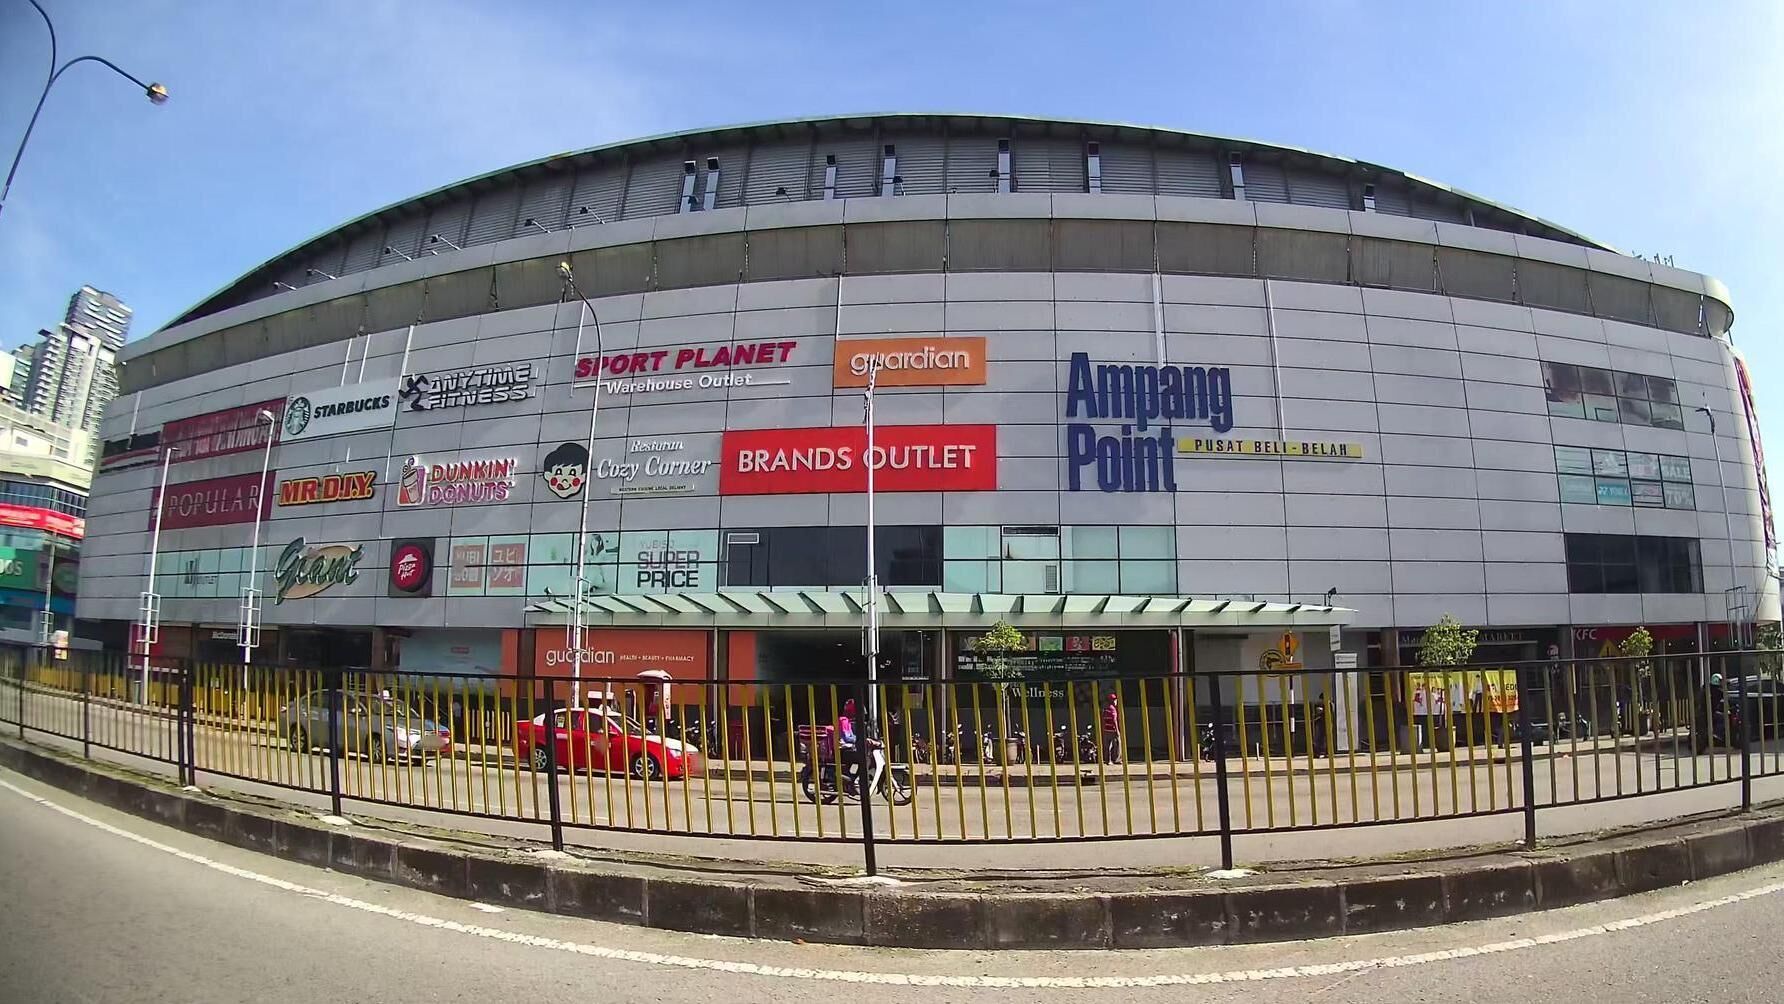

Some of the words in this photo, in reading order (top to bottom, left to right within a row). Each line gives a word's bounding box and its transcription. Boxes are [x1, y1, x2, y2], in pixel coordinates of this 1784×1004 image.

[575, 350, 668, 378] SPORT
[674, 342, 797, 370] PLANET
[850, 346, 970, 376] guardian
[430, 363, 532, 393] ANYTIME
[606, 378, 693, 395] Warehouse
[699, 373, 753, 389] Outlet
[427, 383, 529, 410] FITNESS
[1066, 352, 1234, 433] Ampang
[313, 395, 391, 418] STARBUCKS
[630, 440, 684, 453] Restoran
[738, 447, 852, 473] BRANDS
[863, 445, 977, 470] OUTLET
[1067, 423, 1178, 493] Point
[1195, 439, 1243, 453] PUSAT
[430, 459, 517, 482] DUNKIN'
[596, 458, 639, 482] Cozy
[645, 456, 712, 476] Corner
[166, 484, 260, 518] POPULAR
[279, 480, 318, 506] MR
[428, 481, 509, 505] DONUTS
[274, 536, 364, 606] Giant
[637, 551, 700, 569] SUPER
[637, 570, 699, 588] PRICE
[1576, 628, 1598, 640] KFC
